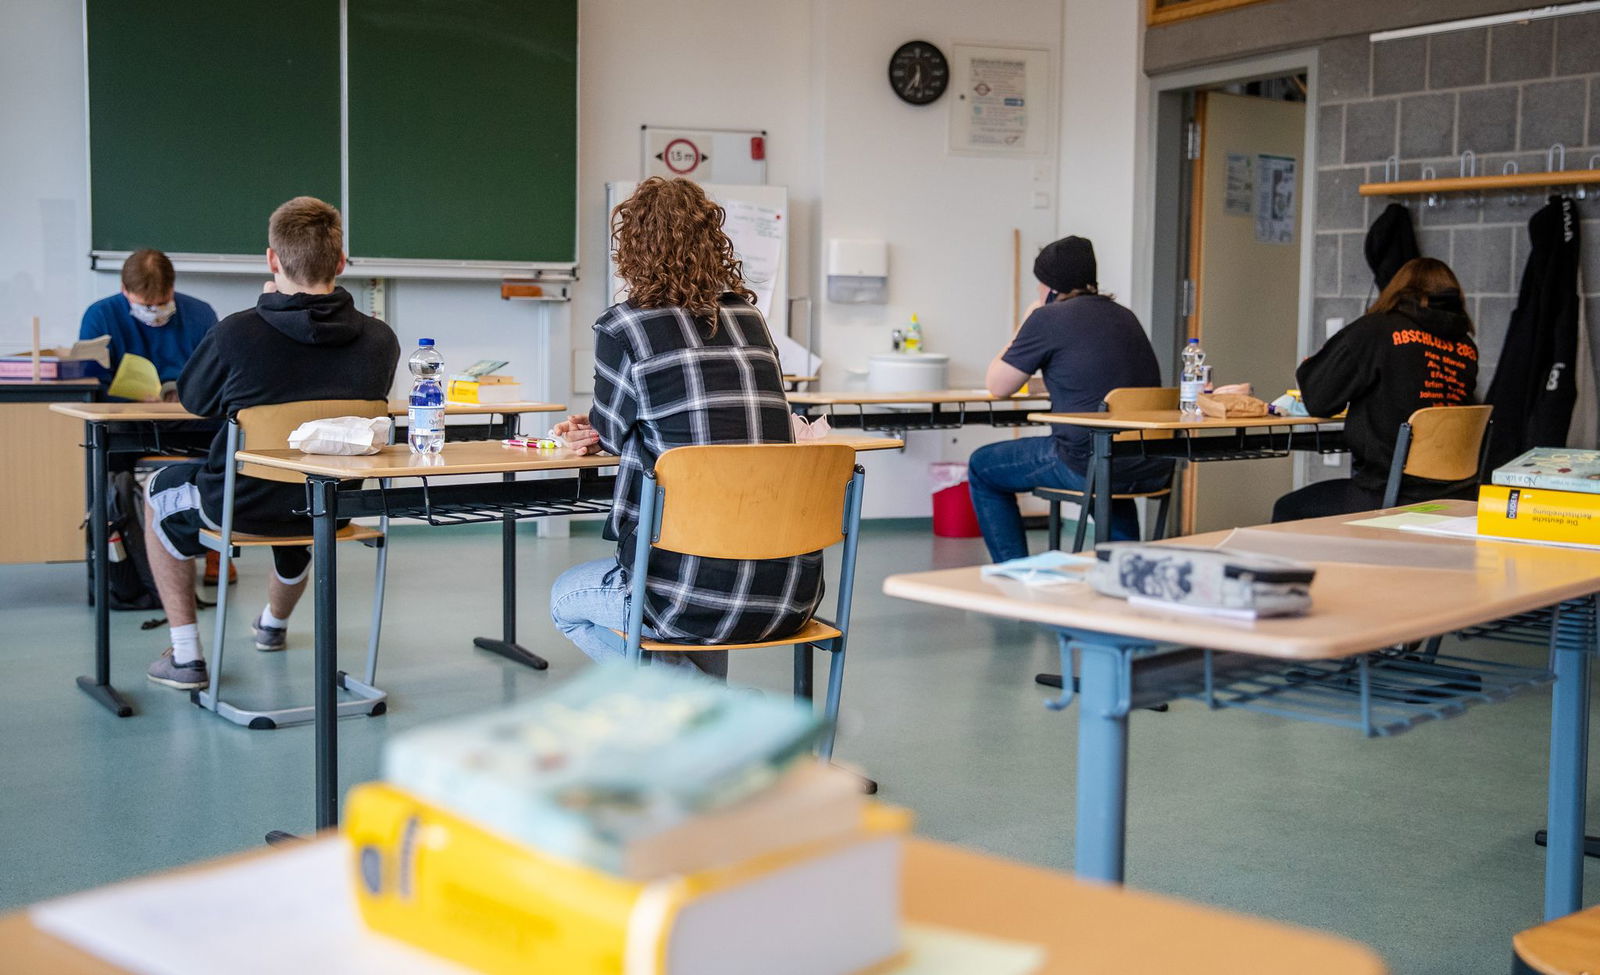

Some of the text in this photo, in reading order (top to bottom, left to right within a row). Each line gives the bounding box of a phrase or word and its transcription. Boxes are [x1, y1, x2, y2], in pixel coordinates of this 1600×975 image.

[1392, 329, 1454, 352] ABSCHLUSS
[1420, 391, 1444, 399] Johann
[1508, 493, 1518, 519] DUDEN
[1532, 508, 1592, 520] Rechtschreibung
[1532, 516, 1564, 525] deutsche
